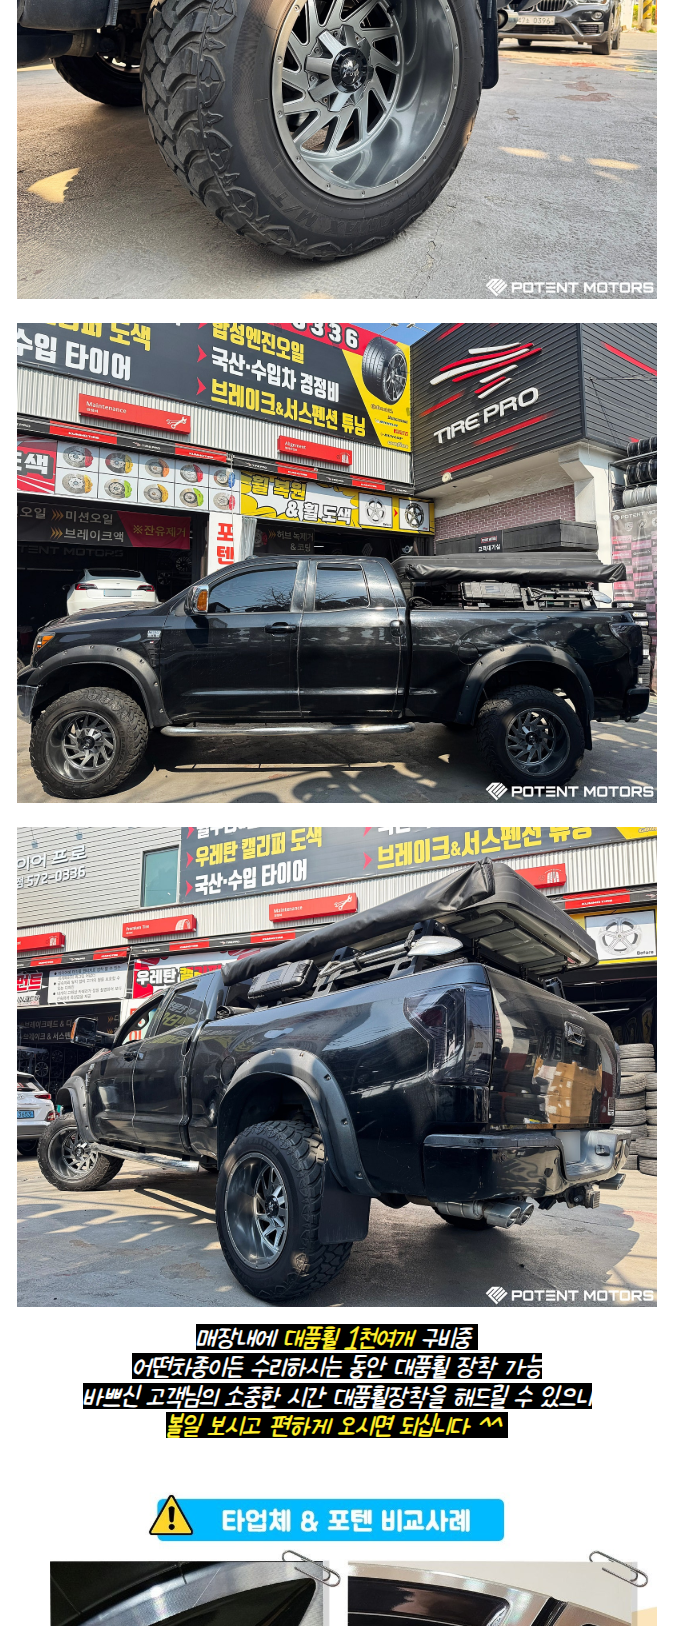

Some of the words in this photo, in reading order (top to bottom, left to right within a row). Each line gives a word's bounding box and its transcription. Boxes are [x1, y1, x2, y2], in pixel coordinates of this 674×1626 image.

[65, 339, 131, 381] 타이어
[211, 345, 297, 391] 국산·수입차
[300, 370, 340, 404] 경정비
[85, 400, 128, 414] Maintenance
[210, 378, 339, 432] 브레이크&서스펜션
[341, 412, 367, 437] 튜닝
[433, 412, 481, 444] TIRE
[483, 386, 540, 424] PRO
[65, 508, 113, 525] 미션오일
[285, 500, 300, 518] &
[303, 503, 320, 521] 휠
[321, 505, 352, 525] 도색
[63, 527, 125, 542] 브레이크액
[50, 844, 88, 866] 프로
[195, 840, 239, 868] 우레탄
[241, 831, 286, 861] 캘리퍼
[290, 827, 323, 853] 도색
[26, 866, 87, 888] 572-0336
[194, 866, 257, 896] 국산·수입
[261, 858, 308, 887] 타이어
[136, 967, 178, 987] 우레탄
[222, 1508, 291, 1532] 타업체
[301, 1510, 319, 1532] &
[328, 1509, 372, 1532] 포텐
[382, 1509, 470, 1532] 비교사례
